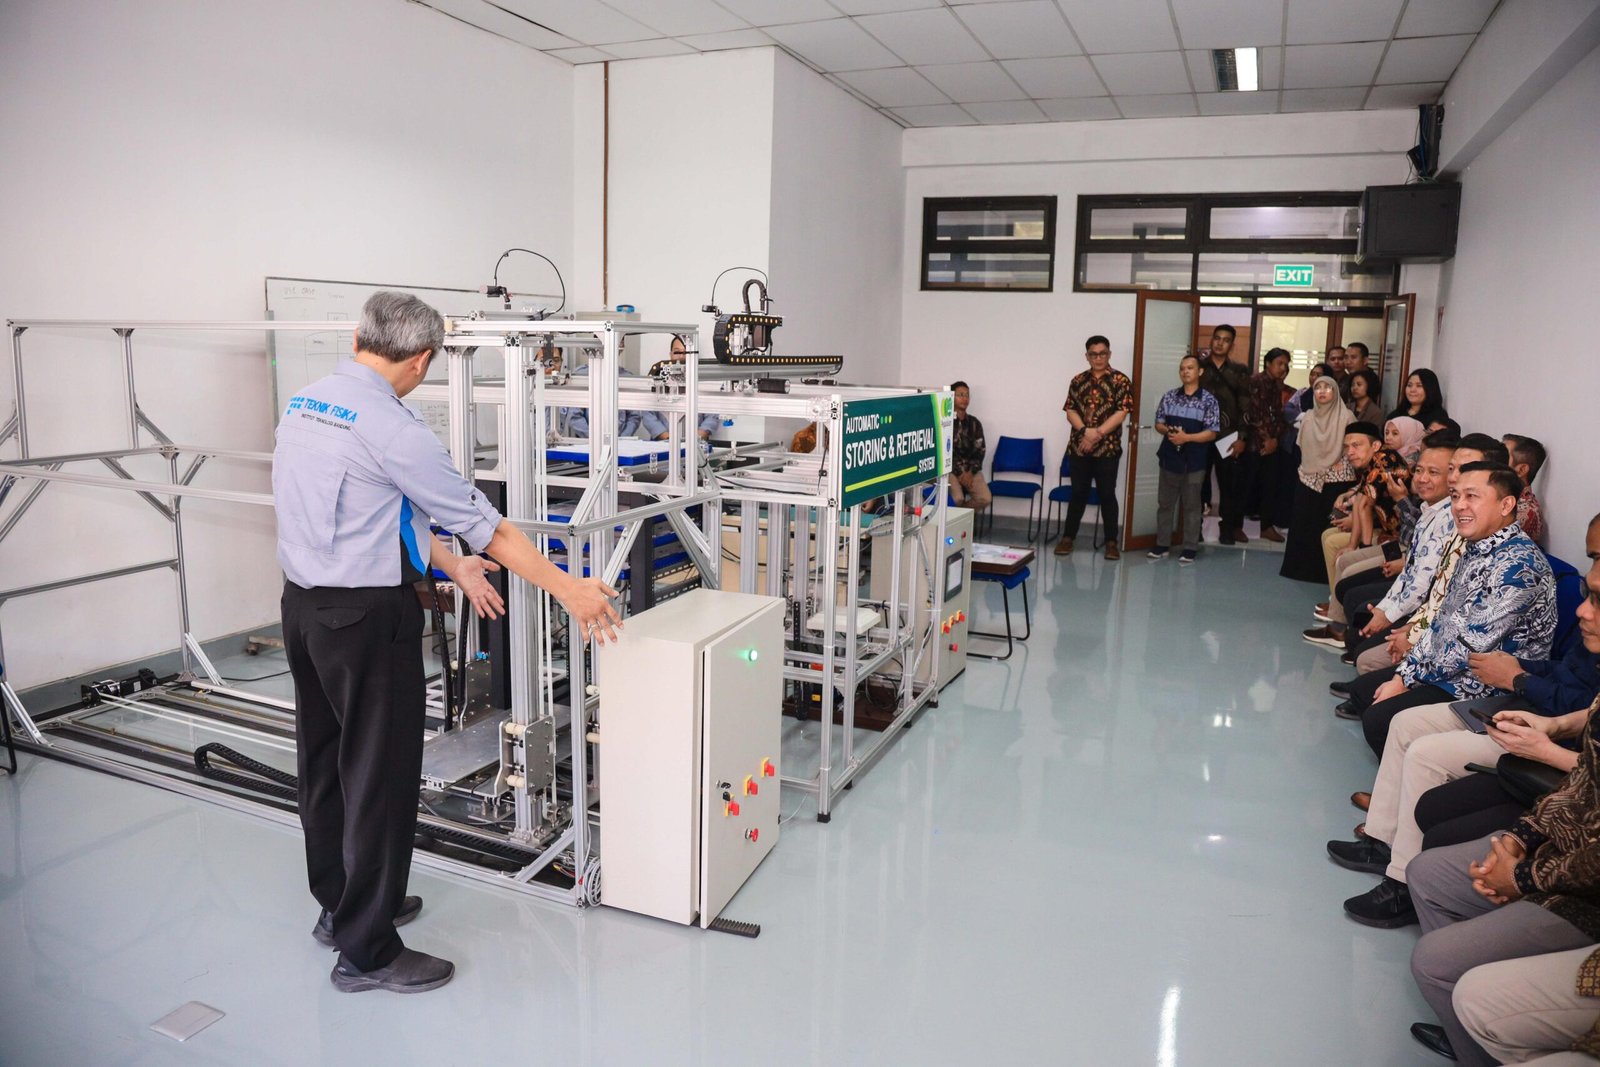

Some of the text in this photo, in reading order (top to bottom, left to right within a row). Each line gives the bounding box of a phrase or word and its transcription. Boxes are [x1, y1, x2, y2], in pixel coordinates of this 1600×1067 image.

[1276, 269, 1311, 281] EXIT
[304, 398, 358, 423] TEKNIK FISIKA
[845, 414, 879, 434] AUTOMATIC
[845, 427, 935, 470] STORING & RETRIEVAL
[918, 456, 936, 474] SYSTEM
